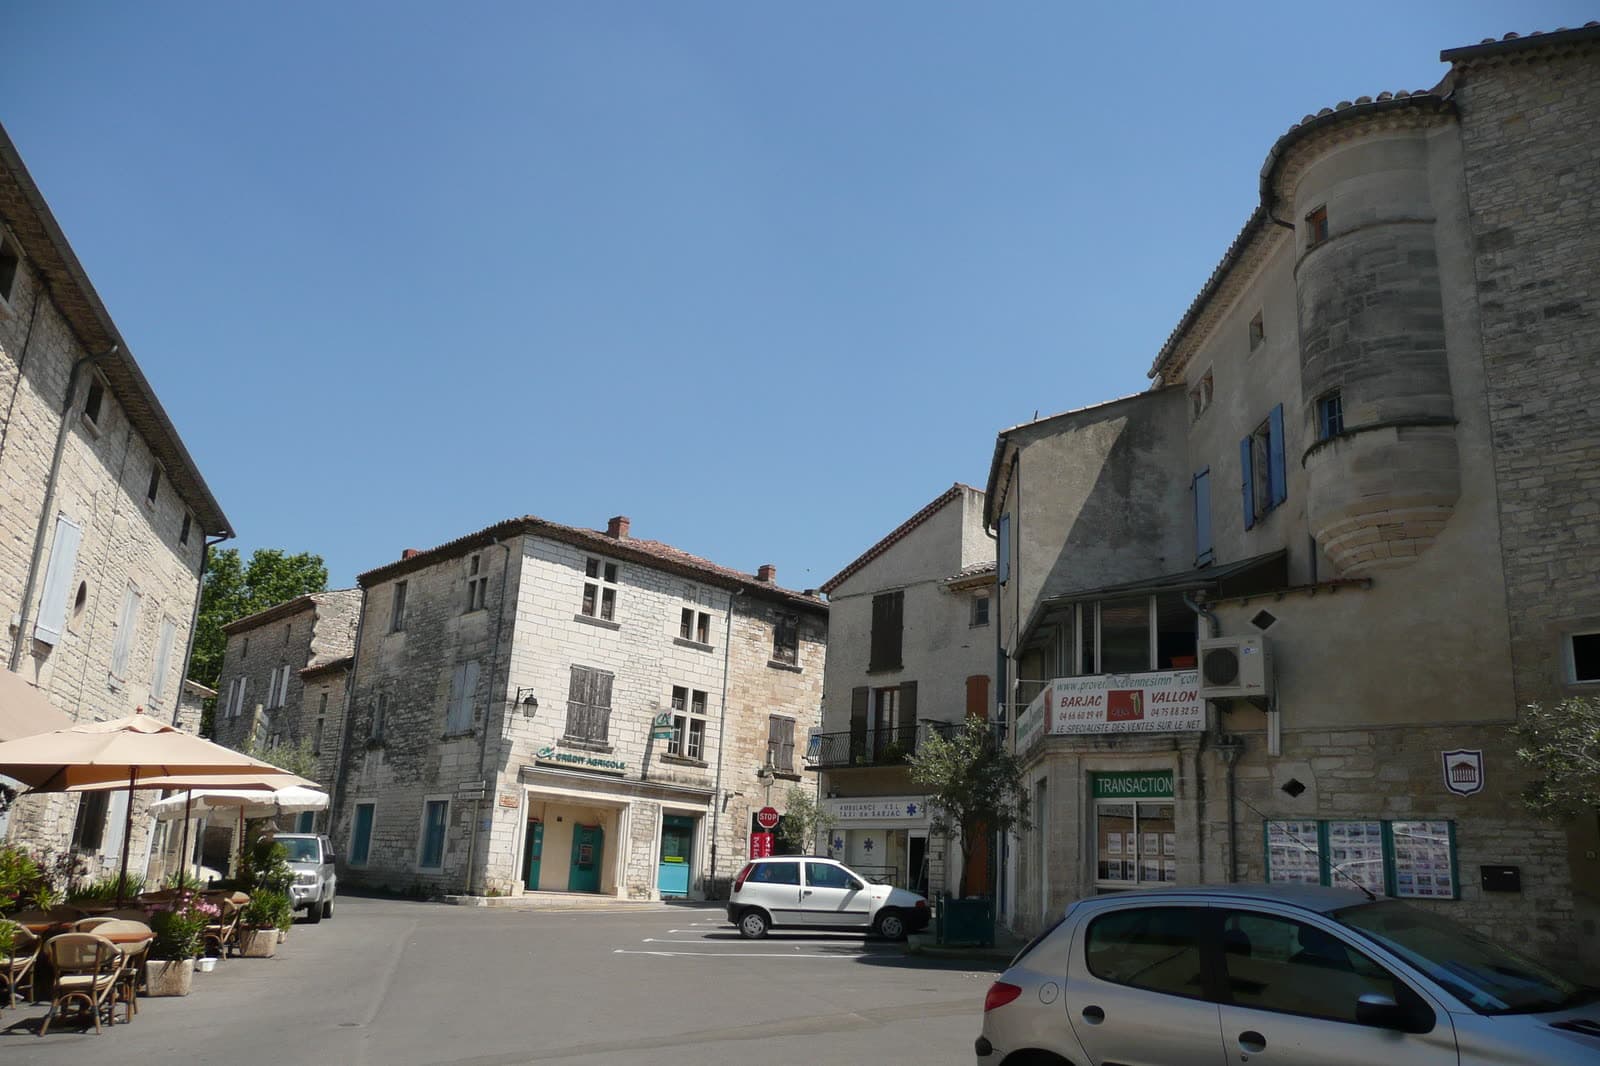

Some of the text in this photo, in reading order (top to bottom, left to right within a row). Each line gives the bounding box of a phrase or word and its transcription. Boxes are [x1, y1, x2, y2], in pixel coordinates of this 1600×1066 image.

[1060, 695, 1103, 708] BARJAC
[1151, 690, 1198, 704] VALLON
[1151, 708, 1159, 717] 04
[1056, 725, 1065, 733] LE
[1111, 722, 1126, 731] DES
[1127, 721, 1154, 731] VENTES
[1156, 720, 1173, 730] SUR
[1174, 720, 1184, 730] LE
[1186, 719, 1201, 729] NET
[586, 757, 625, 770] AGRICOLE
[1098, 776, 1173, 793] TRANSACTION
[759, 813, 777, 821] STOP
